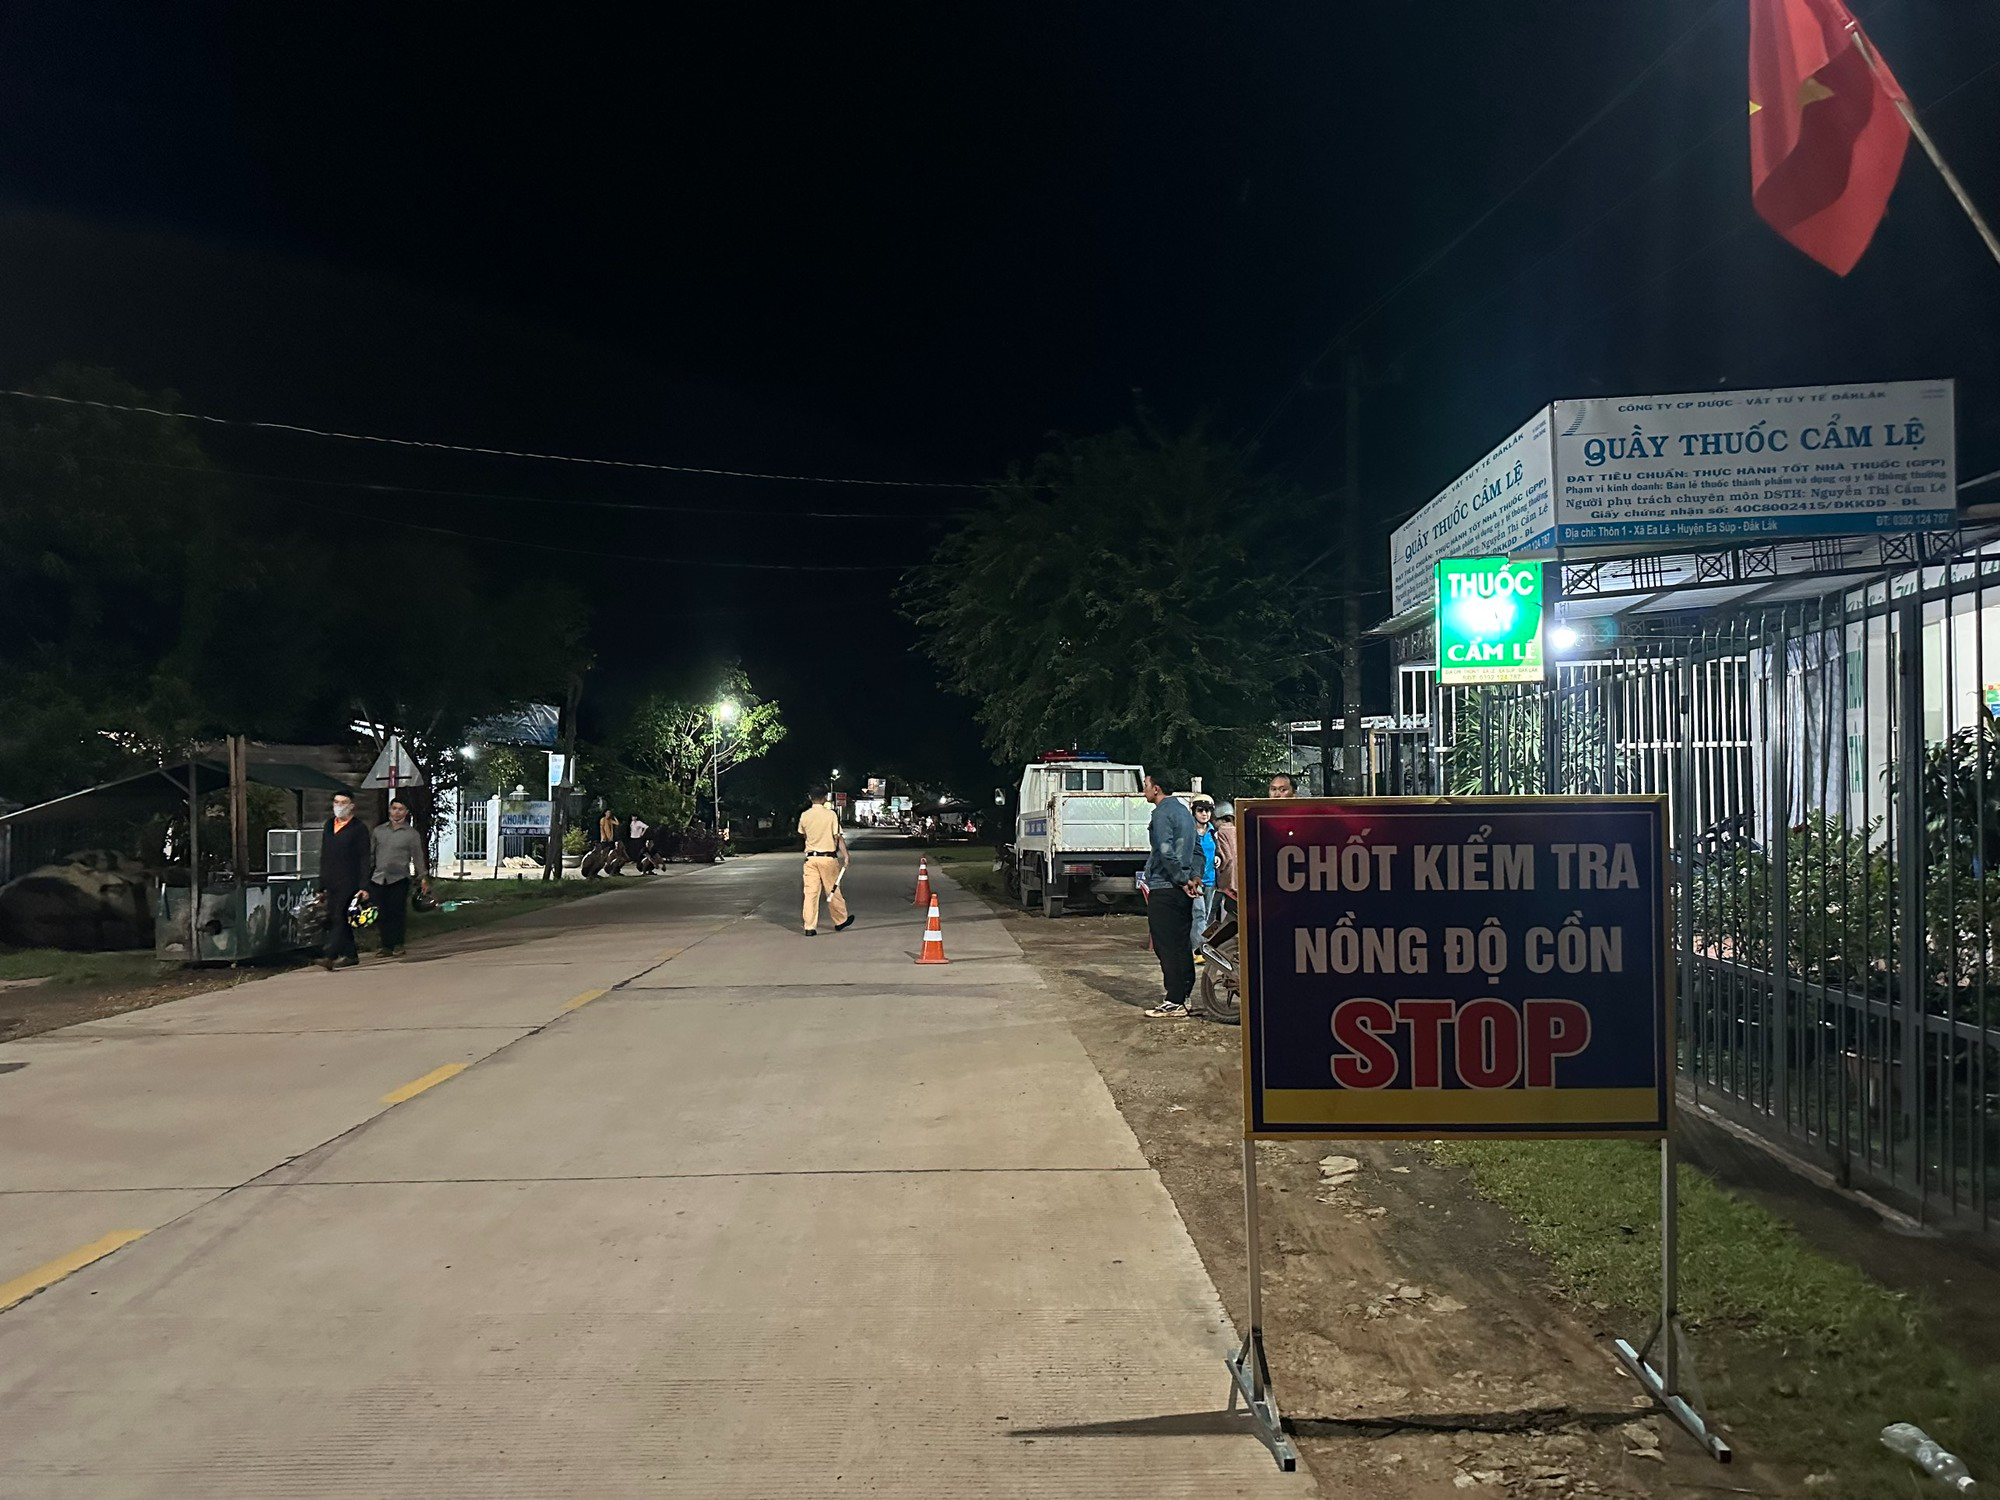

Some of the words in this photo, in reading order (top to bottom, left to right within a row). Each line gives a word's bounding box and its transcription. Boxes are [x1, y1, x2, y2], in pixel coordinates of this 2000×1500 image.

[1618, 403, 1652, 412] CÔNG
[1698, 399, 1733, 408] DƯỢC
[1746, 397, 1770, 405] VẬT
[1811, 392, 1827, 402] TẾ
[1584, 424, 1669, 466] QUẦY
[1679, 419, 1788, 456] THUỐC
[1800, 413, 1873, 450] CẨM
[1884, 417, 1925, 450] LỆ
[1566, 486, 1593, 495] Phạm
[1596, 485, 1604, 493] vi
[1607, 483, 1628, 492] kinh
[1631, 482, 1663, 491] doanh:
[1667, 481, 1685, 490] Bán
[1689, 479, 1697, 489] lẻ
[1701, 478, 1729, 488] thuốc
[1733, 478, 1760, 487] thành
[1765, 475, 1792, 486] phẩm
[1796, 476, 1807, 484] và
[1811, 475, 1835, 484] dụng
[1841, 475, 1851, 483] cụ
[1855, 474, 1861, 483] y
[1864, 472, 1874, 481] tế
[1567, 475, 1594, 484] ĐẠT
[1599, 472, 1632, 481] TIÊU
[1693, 468, 1731, 477] THỰC
[1737, 466, 1776, 475] HÀNH
[1782, 463, 1810, 473] TỐT
[1816, 462, 1845, 471] NHÀ
[1852, 459, 1900, 470] THUỐC
[1906, 459, 1946, 468] (GPP)
[1405, 529, 1429, 563] QUẦY
[1432, 500, 1469, 540] THUỐC
[1472, 477, 1502, 511] CẨM
[1505, 459, 1524, 490] LỆ
[1469, 520, 1481, 533] TỐT
[1482, 511, 1497, 524] NHÀ
[1500, 492, 1523, 514] THUỐC
[1526, 478, 1547, 497] (GPP)
[1566, 498, 1602, 510] Người
[1607, 496, 1632, 508] phụ
[1638, 494, 1671, 504] trách
[1677, 493, 1724, 504] chuyên
[1729, 491, 1759, 501] môn
[1764, 490, 1806, 500] DSTH:
[1811, 485, 1862, 499] Nguyễn
[1867, 485, 1889, 496] Thị
[1591, 509, 1619, 519] Giấy
[1624, 508, 1665, 517] chứng
[1671, 507, 1703, 516] nhận
[1708, 504, 1728, 514] số:
[1902, 498, 1921, 506] ĐL
[1565, 528, 1579, 540] Địa
[1581, 527, 1596, 537] chỉ:
[1598, 526, 1620, 537] Thôn
[1622, 525, 1626, 536] 1
[1634, 525, 1645, 536] Xã
[1646, 524, 1658, 535] Ea
[1660, 523, 1670, 534] Lê
[1677, 522, 1704, 536] Huyện
[1706, 522, 1718, 533] Ea
[1719, 520, 1736, 534] Súp
[1876, 515, 1890, 526] ĐT:
[1916, 514, 1931, 524] 124
[1934, 513, 1949, 524] 787
[1448, 563, 1534, 598] THUỐC
[1447, 636, 1504, 661] CẨM
[1513, 639, 1537, 663] LỆ
[1276, 828, 1397, 891] CHỐT
[1414, 825, 1535, 890] KIỂM
[1550, 843, 1640, 889] TRA
[1295, 911, 1428, 974] NỒNG
[1444, 917, 1507, 984] ĐỘ
[1525, 911, 1622, 973] CỒN
[1330, 997, 1591, 1089] STOP
